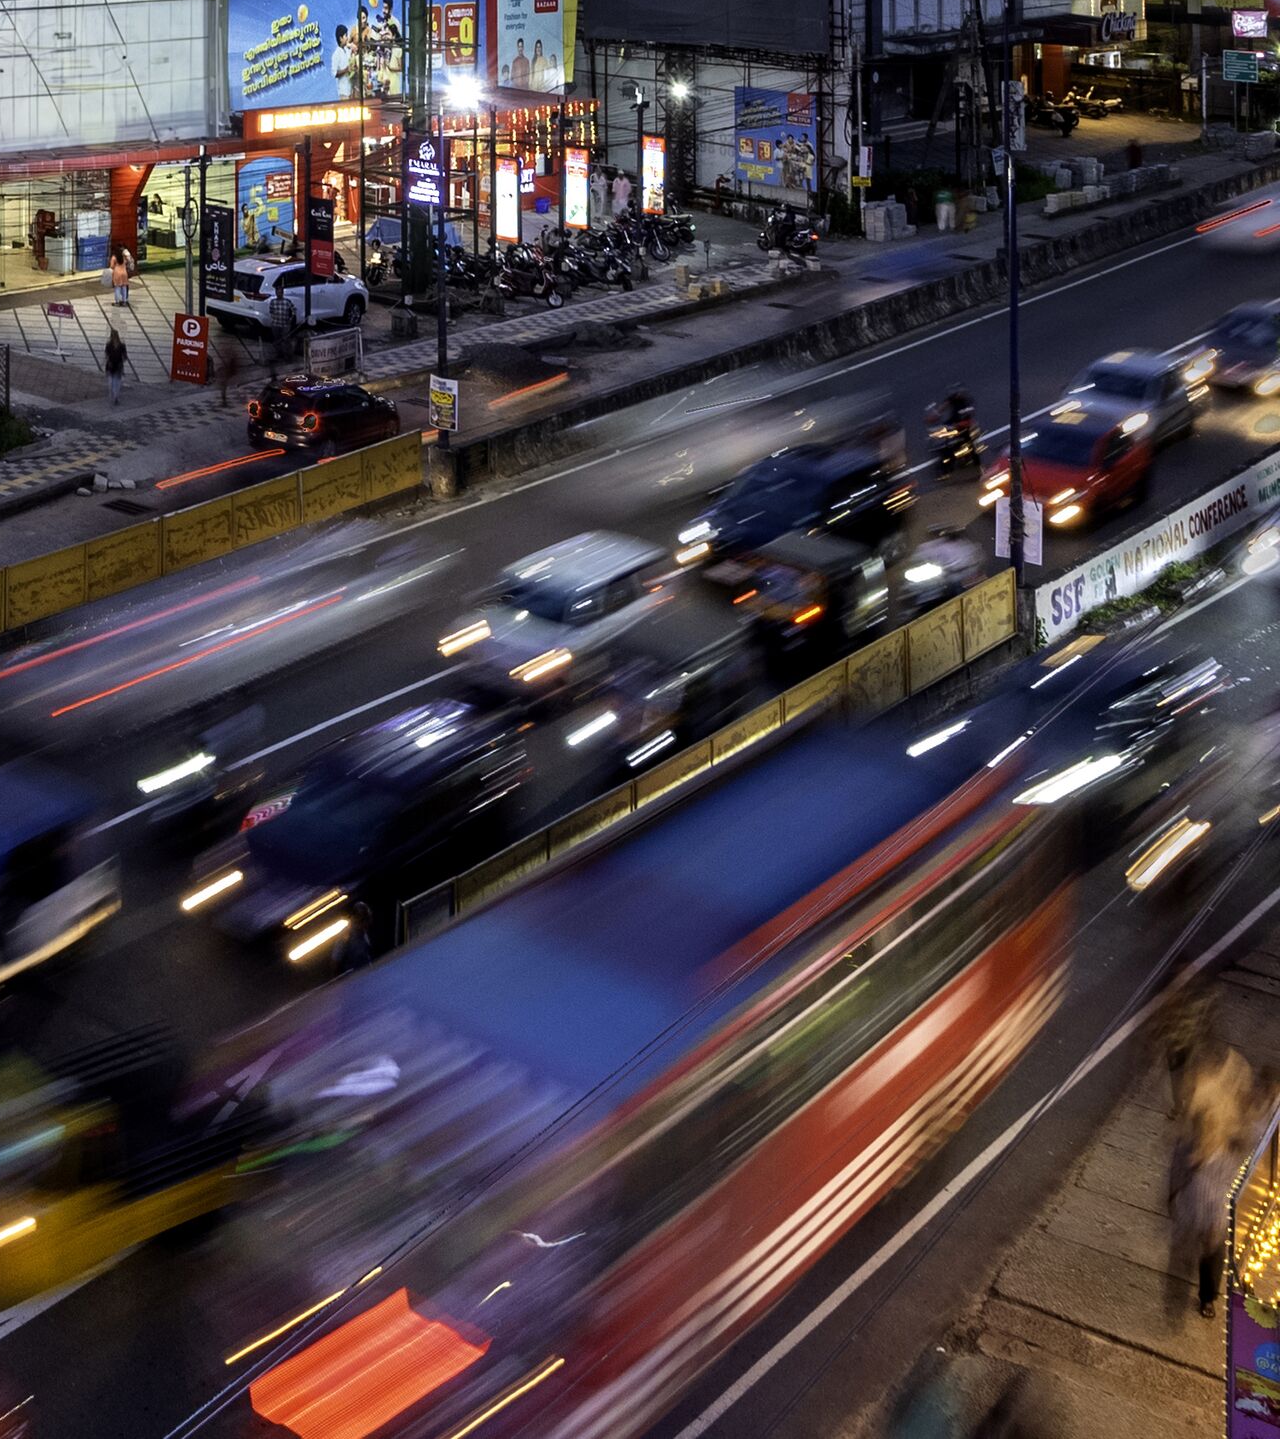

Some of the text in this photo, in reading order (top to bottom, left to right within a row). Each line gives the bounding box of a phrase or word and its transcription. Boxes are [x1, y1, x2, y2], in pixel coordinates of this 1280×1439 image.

[176, 338, 204, 349] PARKING
[1051, 573, 1086, 626] SSF
[1124, 520, 1188, 577] NATIONAL
[1189, 485, 1248, 539] CONFERENCE
